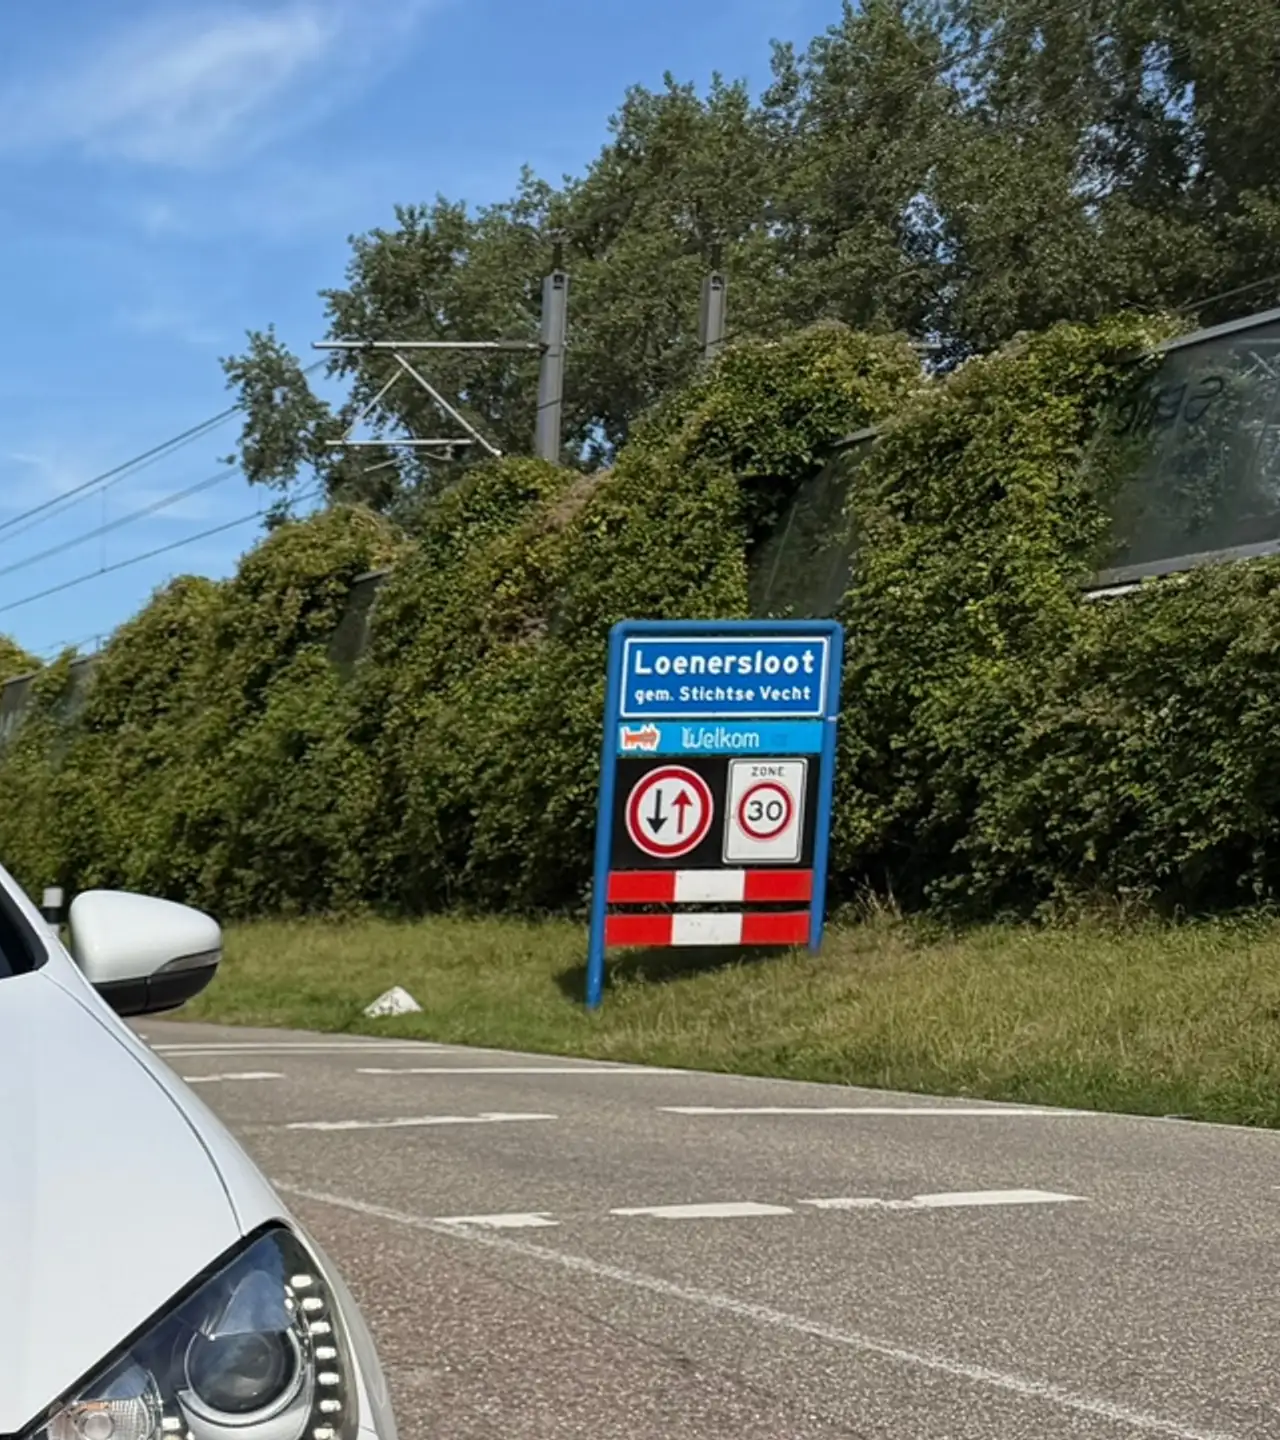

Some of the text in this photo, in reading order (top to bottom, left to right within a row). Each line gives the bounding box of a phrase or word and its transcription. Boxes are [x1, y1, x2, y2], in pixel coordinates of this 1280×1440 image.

[634, 650, 815, 675] Loenersloot
[634, 685, 811, 705] gem. Stichtse Vecht
[682, 726, 760, 748] Welkom
[751, 766, 785, 777] ZONE
[748, 800, 783, 822] 30
